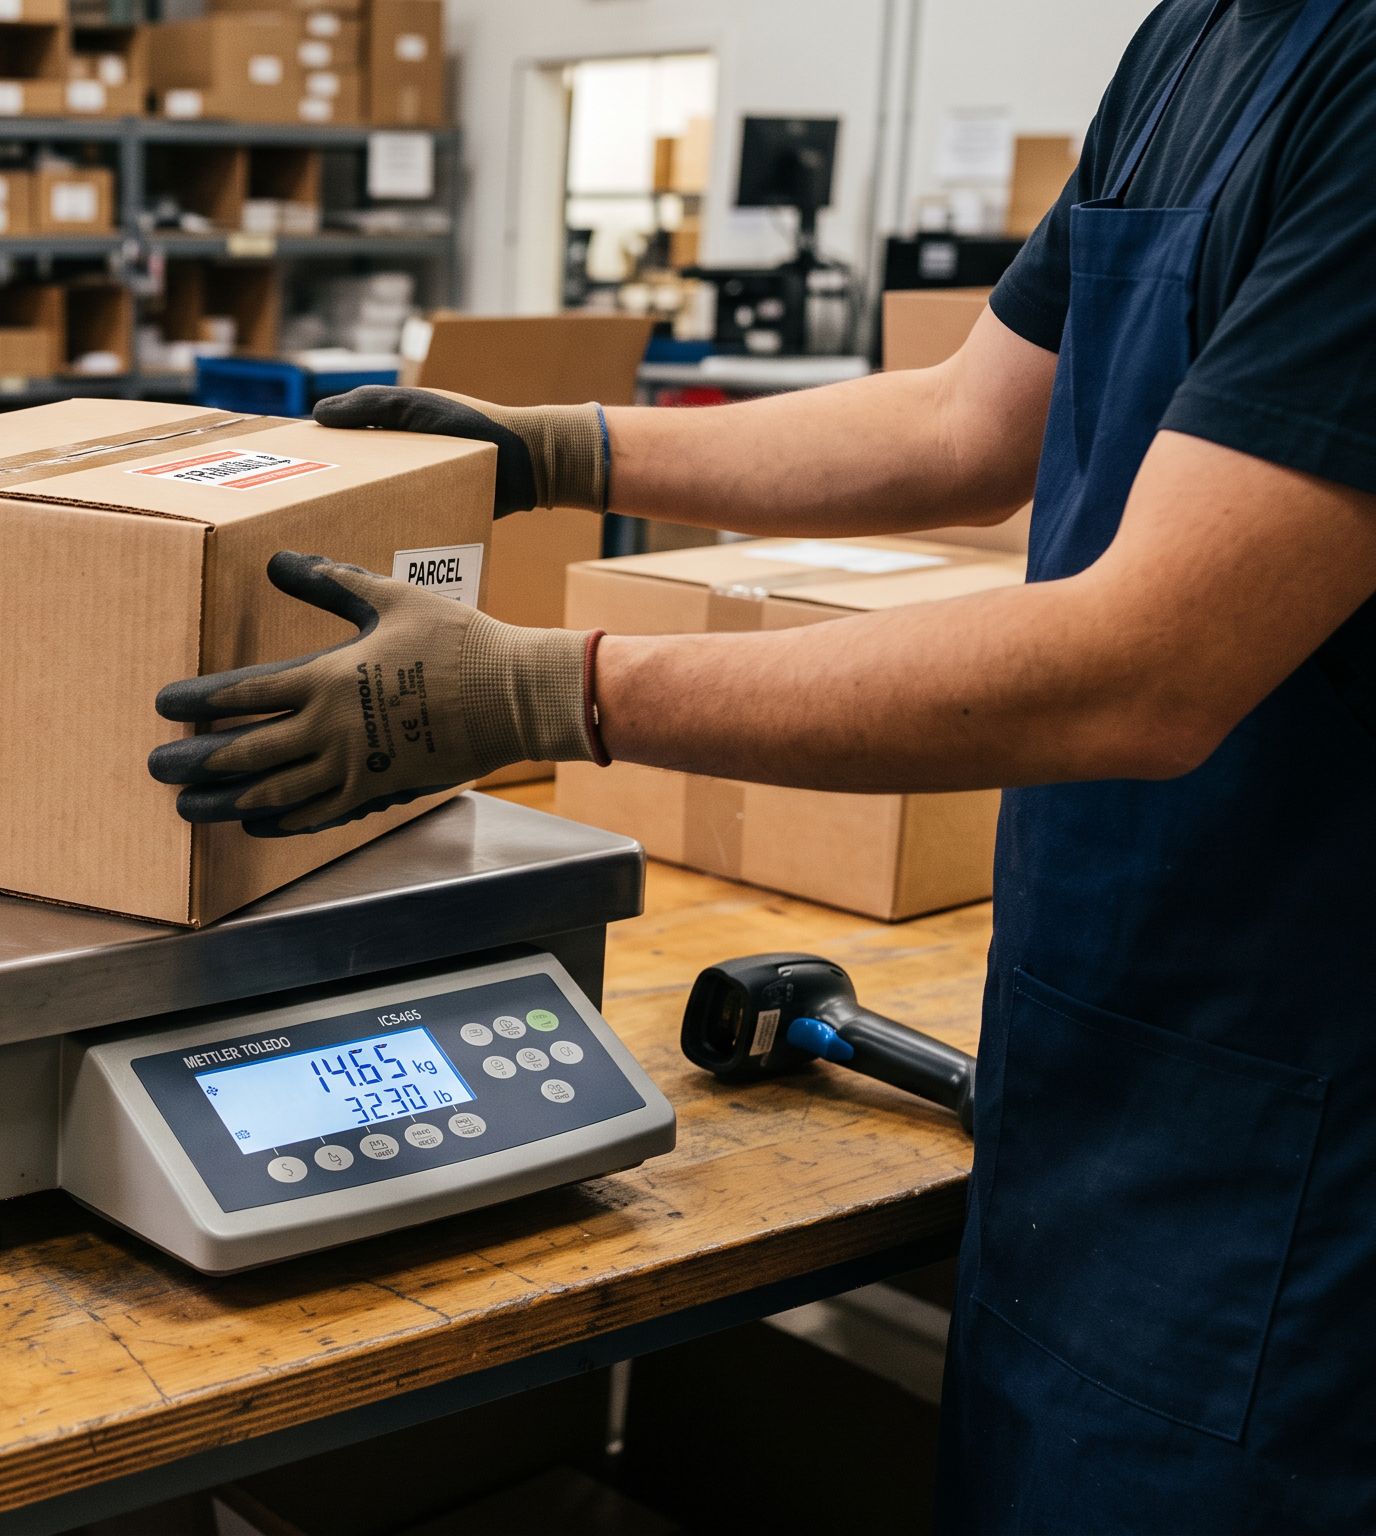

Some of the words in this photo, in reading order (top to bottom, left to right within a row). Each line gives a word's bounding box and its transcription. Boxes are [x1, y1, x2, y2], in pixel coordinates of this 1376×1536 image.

[407, 558, 463, 586] PARCEL
[377, 1009, 422, 1027] ICS465
[182, 1047, 243, 1069] METTLER
[239, 1036, 291, 1055] TOLEDO
[310, 1043, 408, 1093] 14.65
[412, 1059, 438, 1075] kg
[344, 1083, 429, 1125] 32.30
[433, 1089, 453, 1105] lb
